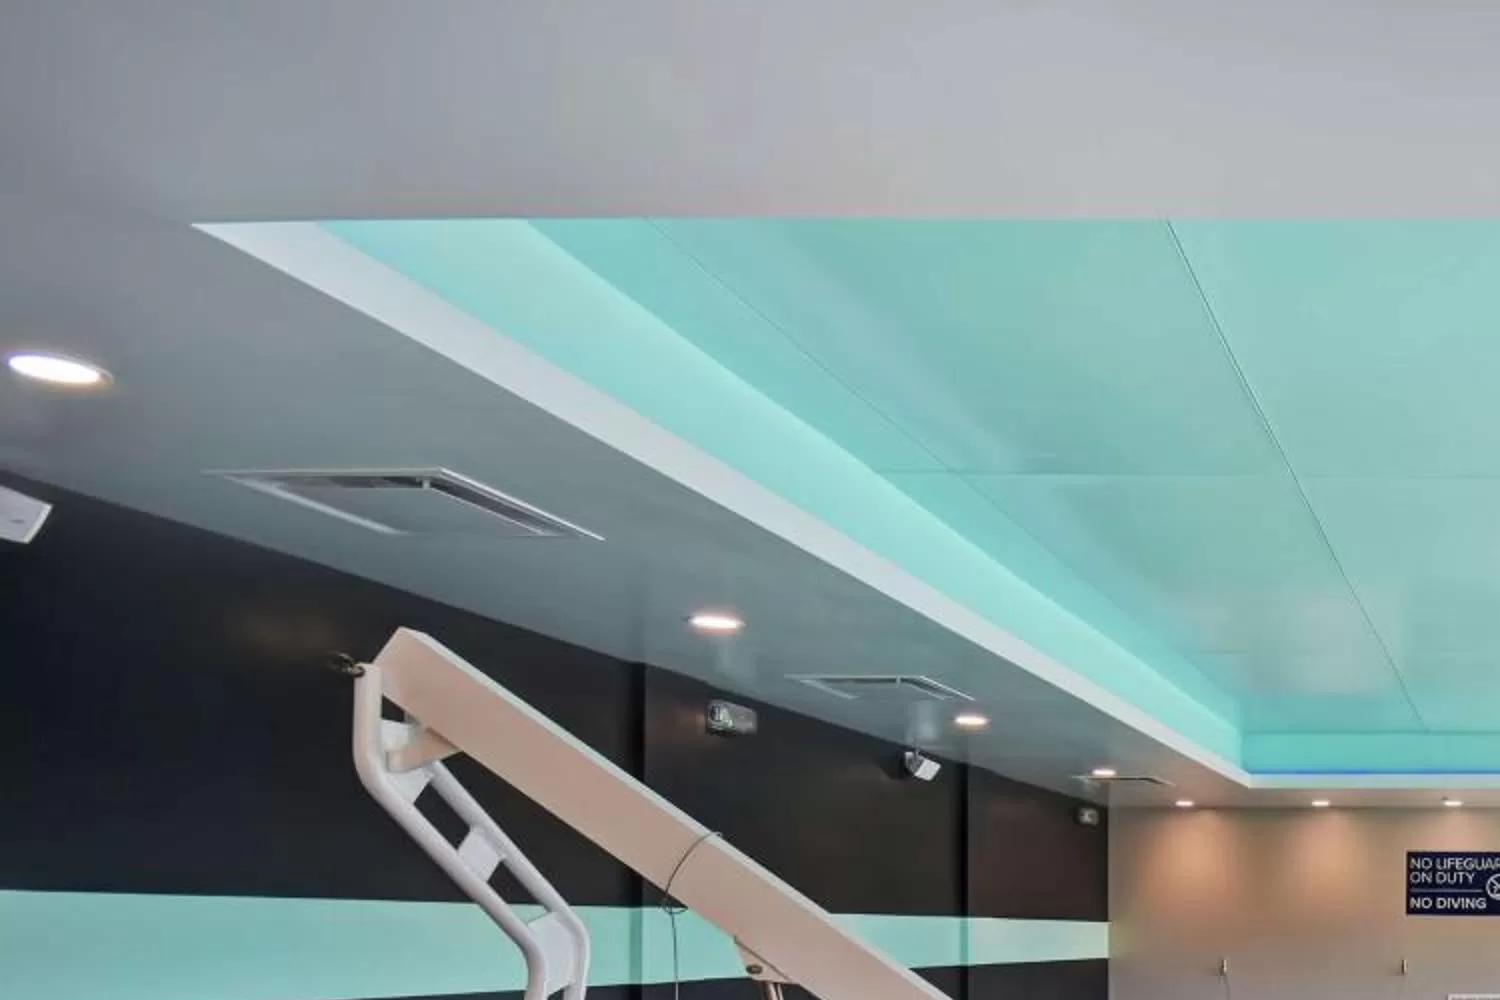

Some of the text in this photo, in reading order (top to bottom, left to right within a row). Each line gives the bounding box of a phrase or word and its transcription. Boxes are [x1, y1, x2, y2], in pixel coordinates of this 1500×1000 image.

[1410, 858, 1432, 869] NO
[1410, 872, 1475, 884] ON DUTY
[1410, 898, 1487, 909] NO DIVING
